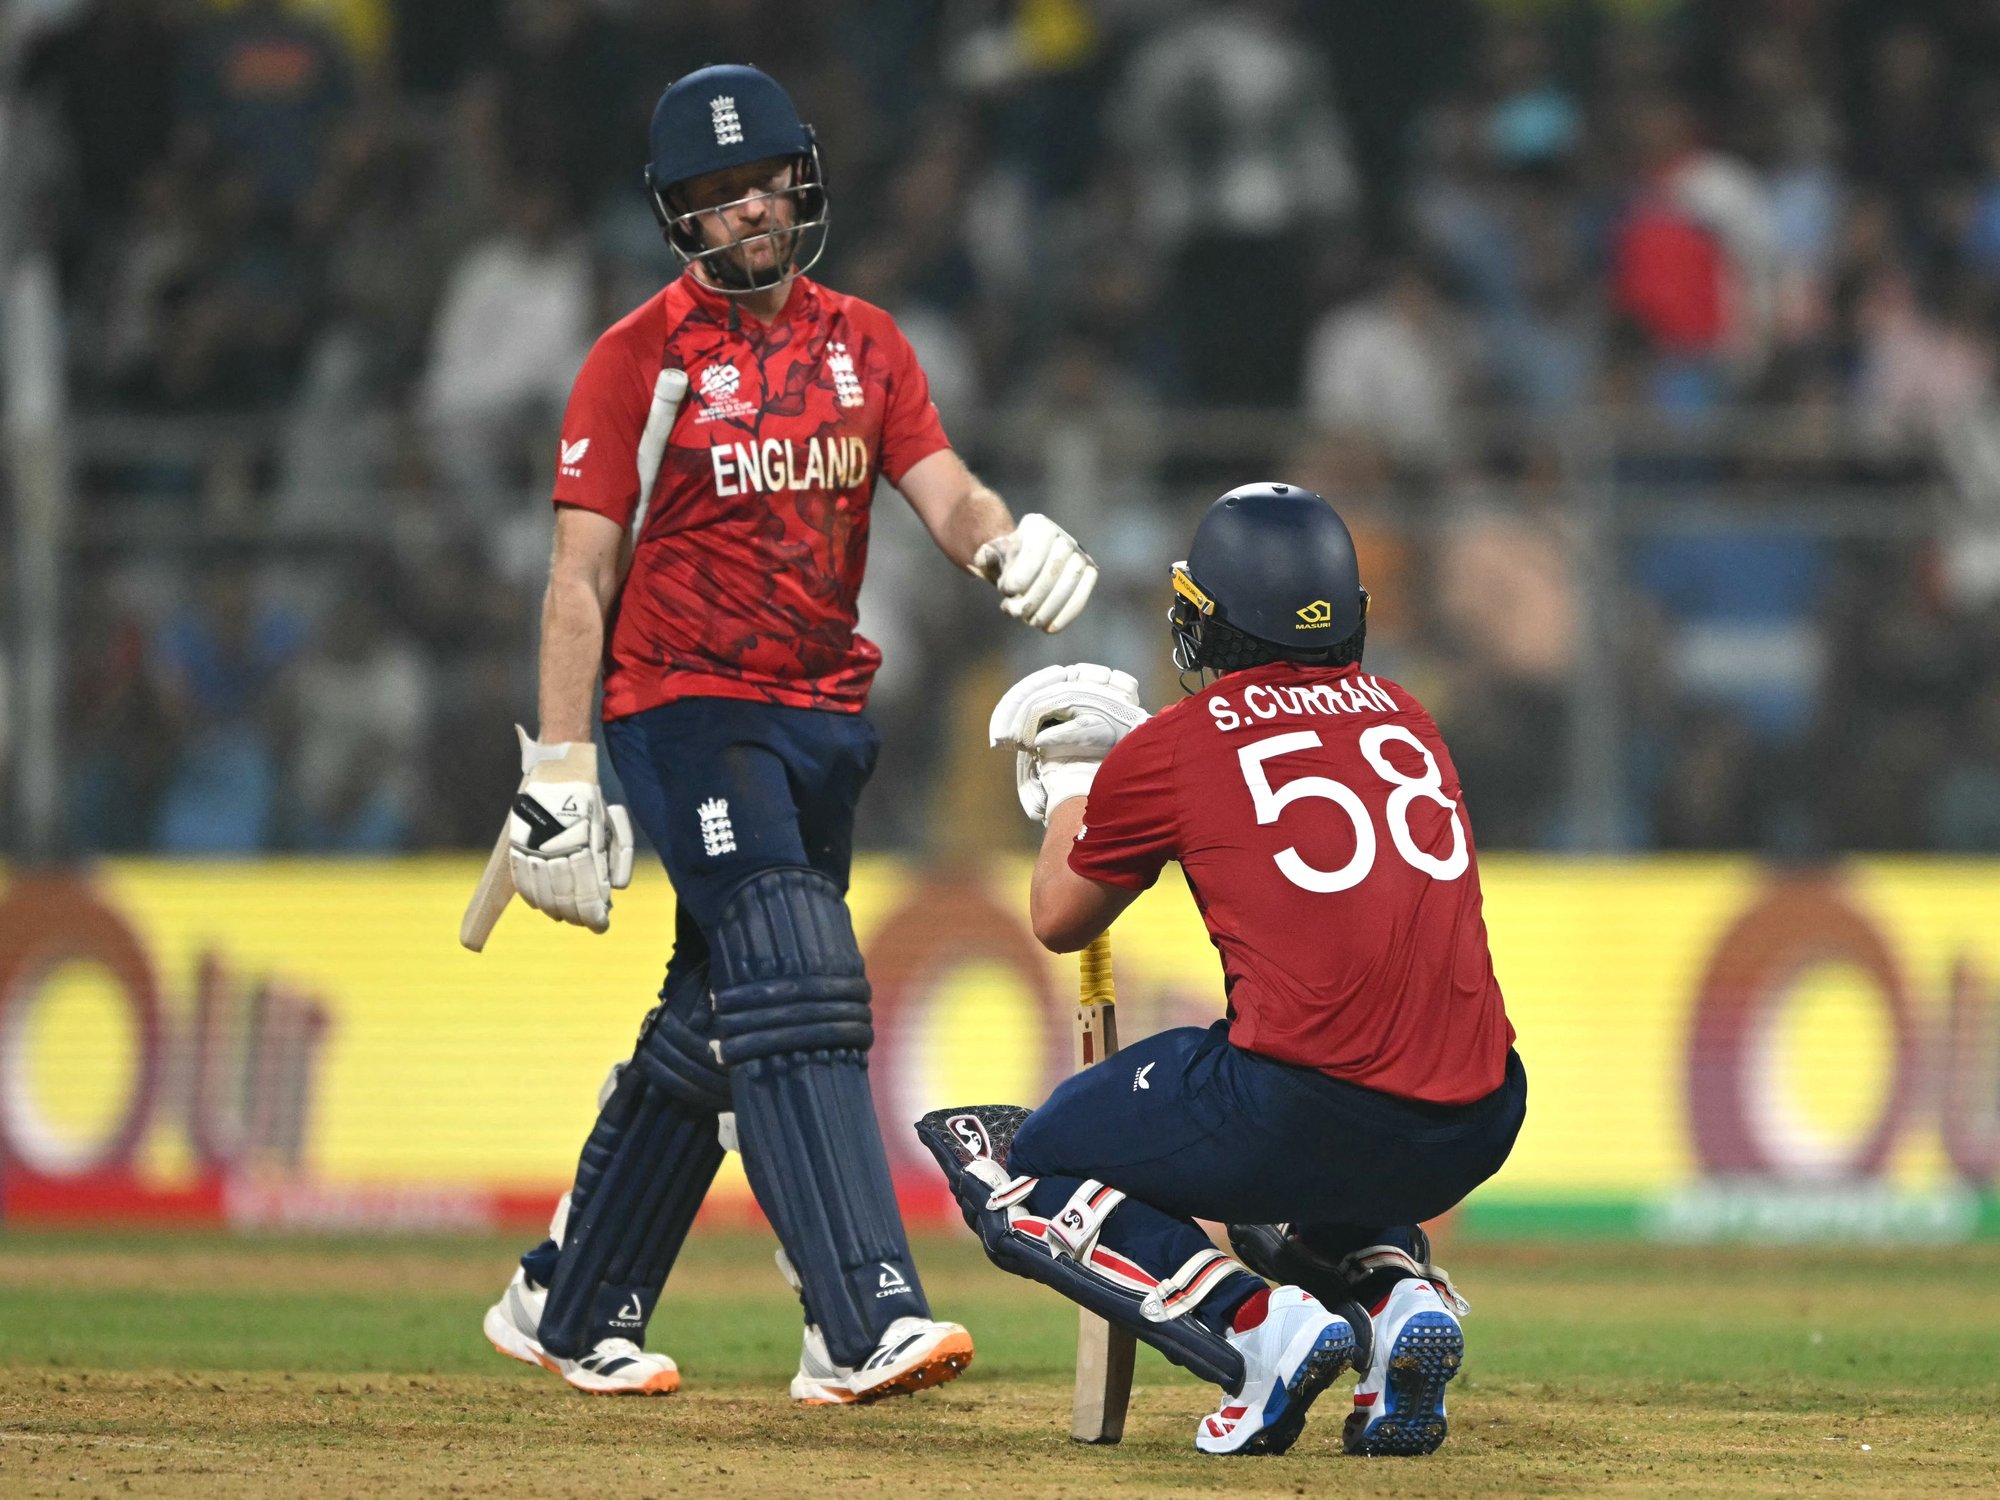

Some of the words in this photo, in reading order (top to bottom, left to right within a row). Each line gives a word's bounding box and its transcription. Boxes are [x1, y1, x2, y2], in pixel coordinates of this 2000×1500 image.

[711, 436, 868, 497] ENGLAND
[1295, 622, 1331, 630] MASURI
[1208, 675, 1400, 732] S.CURRAN
[1237, 724, 1470, 894] 58
[876, 1286, 913, 1299] CHASE
